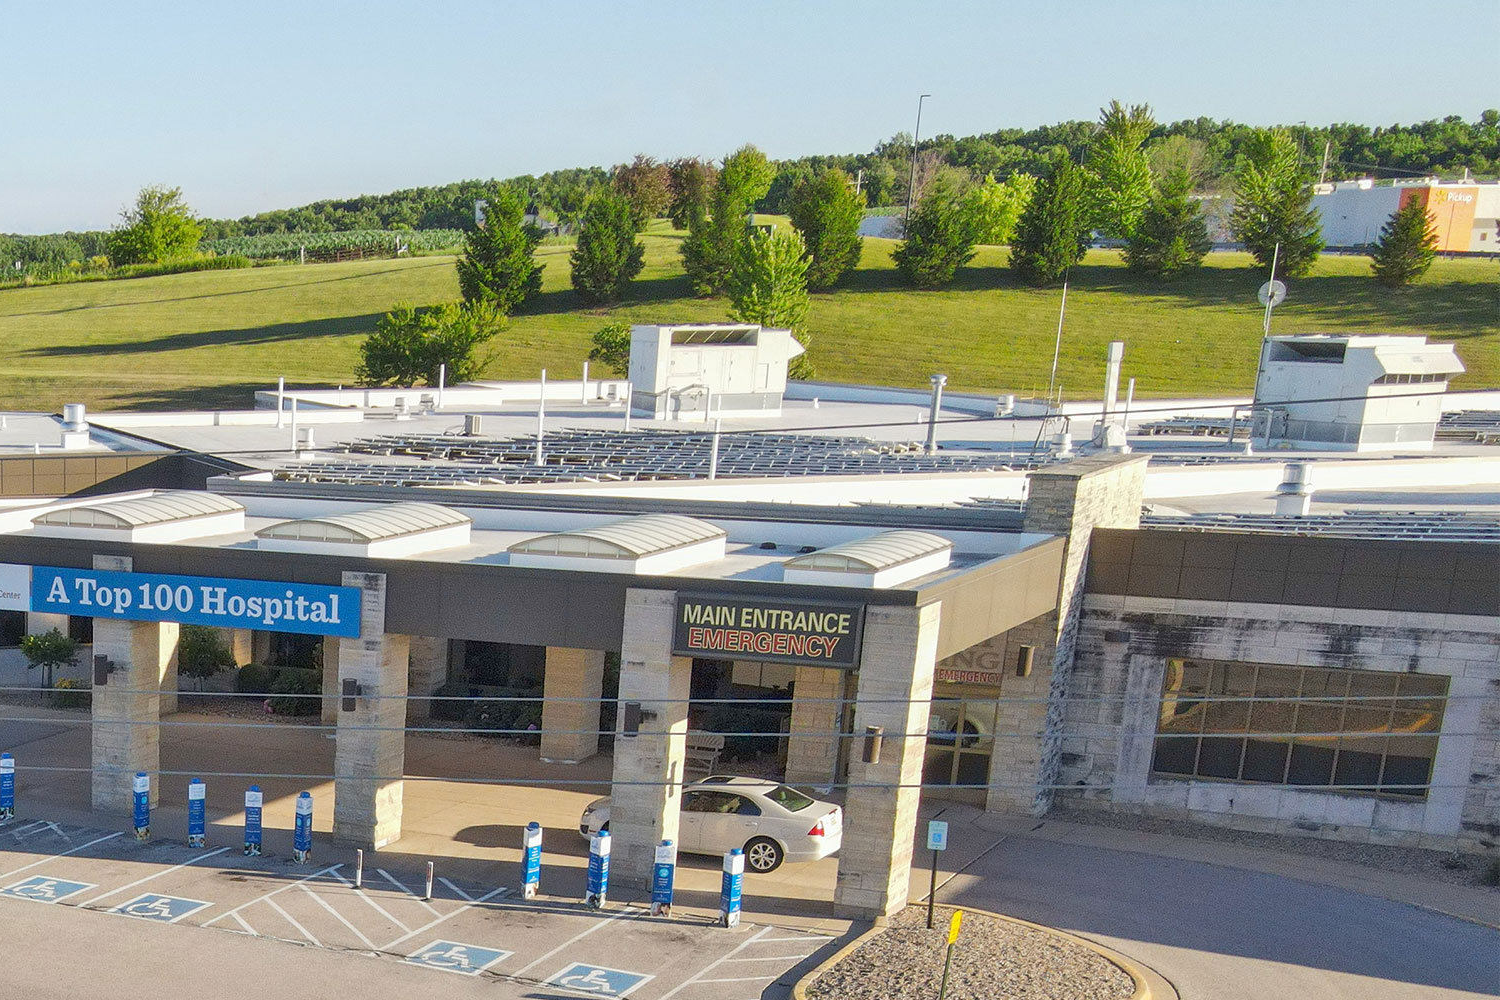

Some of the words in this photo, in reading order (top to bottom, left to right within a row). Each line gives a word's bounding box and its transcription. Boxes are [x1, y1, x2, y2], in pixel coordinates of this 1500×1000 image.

[1447, 192, 1472, 204] Pickup
[46, 576, 70, 603] A
[76, 578, 132, 614] Top
[139, 582, 194, 612] 100
[200, 586, 341, 625] Hospital
[683, 604, 736, 626] MAIN
[740, 608, 851, 634] ENTRANCE
[688, 627, 840, 658] EMERGENCY
[938, 669, 1001, 683] EMERGENCY
